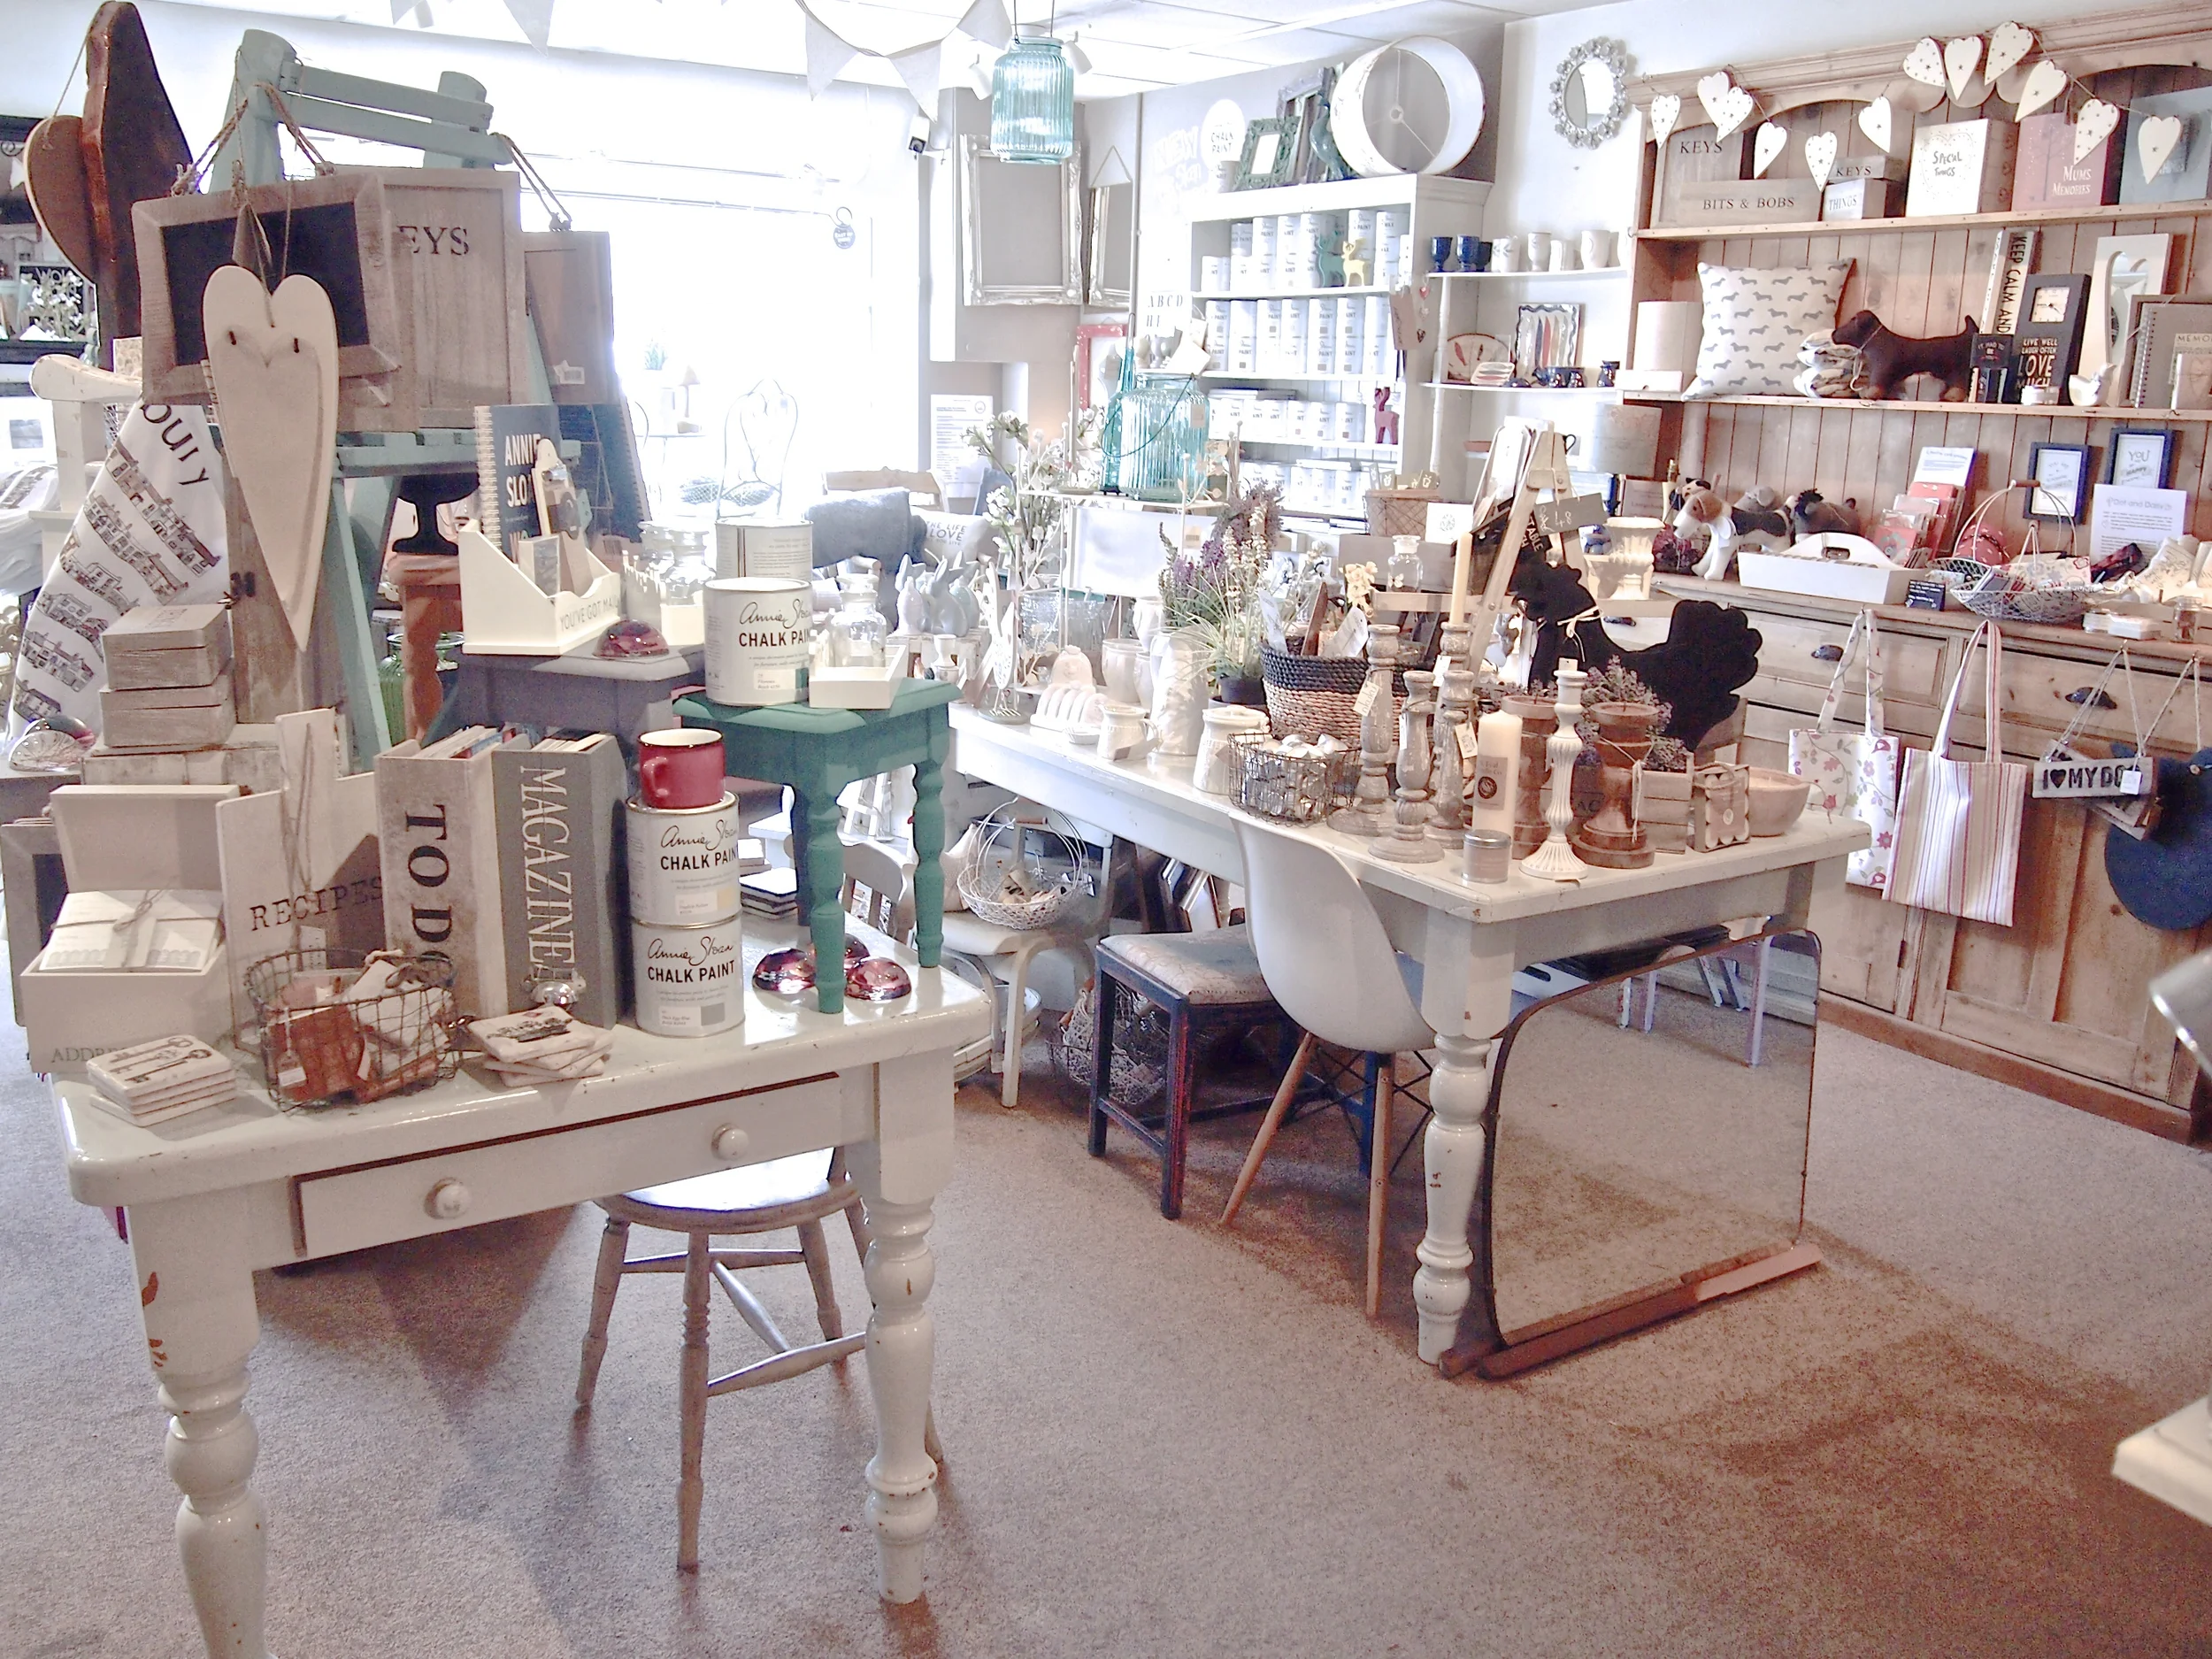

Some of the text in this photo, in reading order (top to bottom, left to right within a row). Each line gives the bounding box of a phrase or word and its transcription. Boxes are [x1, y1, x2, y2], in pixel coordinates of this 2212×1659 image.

[1680, 141, 1723, 154] KEYS
[1836, 165, 1871, 177] KEYS
[1702, 197, 1795, 210] BITS & BOBS
[1829, 195, 1857, 211] THINGS
[396, 226, 469, 255] EYS
[1996, 236, 2027, 334] KEEP CALM AND
[2017, 355, 2055, 377] LOVE
[506, 474, 534, 508] SLO
[930, 528, 964, 541] LOVE
[947, 524, 967, 533] LIFE
[588, 601, 602, 619] GOT
[740, 598, 810, 629] Annie Sloa
[739, 630, 810, 648] CHALK PAIN
[2042, 769, 2048, 790] I
[2069, 766, 2098, 788] MY
[2101, 764, 2142, 788] DO
[404, 803, 449, 887] TO
[661, 819, 736, 850] Annie Sloa
[520, 765, 575, 972] MAGAZINE
[660, 847, 736, 870] CHALK PAIN
[250, 876, 382, 931] RECIPES
[648, 936, 733, 966] Annie Sloan
[648, 960, 734, 983] CHALK PAINT
[51, 1048, 127, 1063] ADDR
